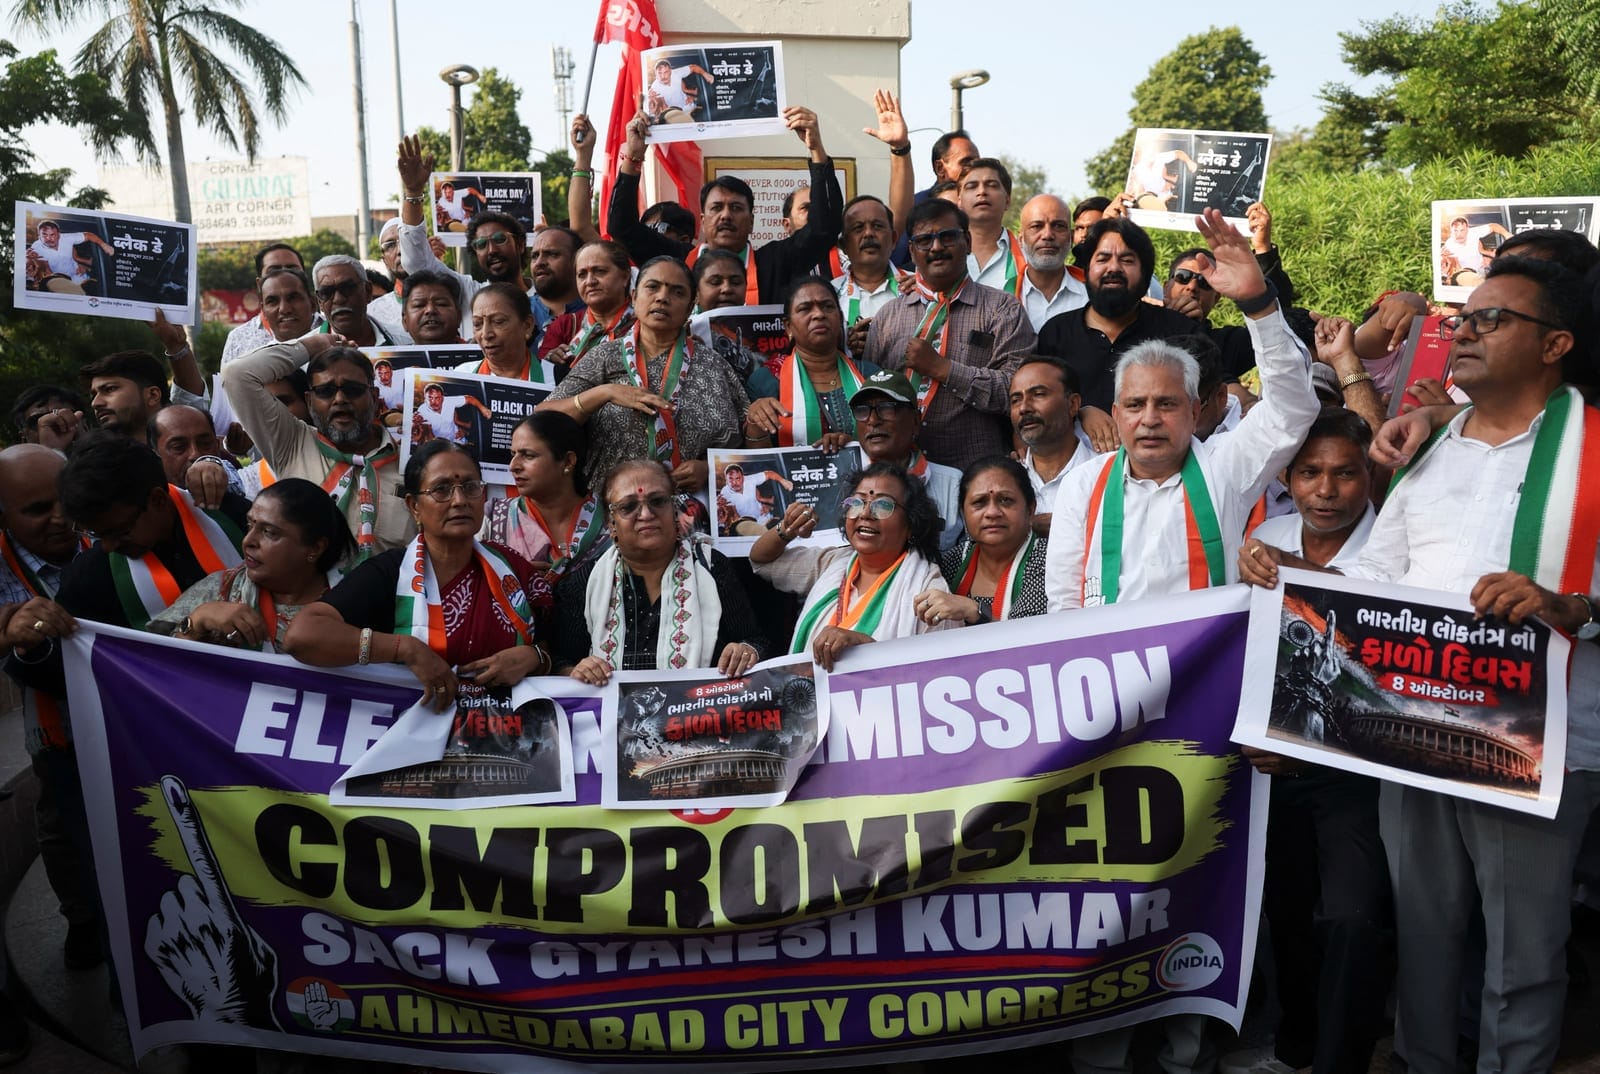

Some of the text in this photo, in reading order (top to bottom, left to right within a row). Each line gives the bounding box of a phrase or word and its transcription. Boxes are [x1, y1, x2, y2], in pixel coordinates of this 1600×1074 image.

[712, 59, 754, 76] ब्लैक डे
[1197, 148, 1242, 168] ब्लैक डे
[209, 163, 263, 175] CONTACT
[745, 178, 771, 188] WEVER
[774, 179, 794, 188] GOOD
[485, 188, 524, 199] BLACK DAY
[206, 199, 293, 214] ART CORNER
[753, 205, 780, 214] ETHER
[112, 232, 164, 254] ब्लैक डे
[750, 232, 774, 240] GOOD
[490, 399, 524, 416] BLACK
[790, 462, 839, 482] ब्लैक डे
[1357, 608, 1537, 654] ભારતીય લોકતંત્ર નો
[1360, 635, 1533, 696] કાળો દિવસ
[696, 687, 704, 697] 8
[1392, 675, 1486, 704] 8 ઓક્ટોબર
[667, 686, 773, 716] ભારતીય લોકતંત્ર નો
[664, 705, 783, 742] કાળો દિવસ
[254, 764, 1184, 930] COMPROMISED
[302, 887, 1171, 987] SACK GYANESH KUMAR
[1172, 955, 1222, 971] INDIA
[360, 961, 1150, 1052] AHMEDABAD CITY CONGRESS
